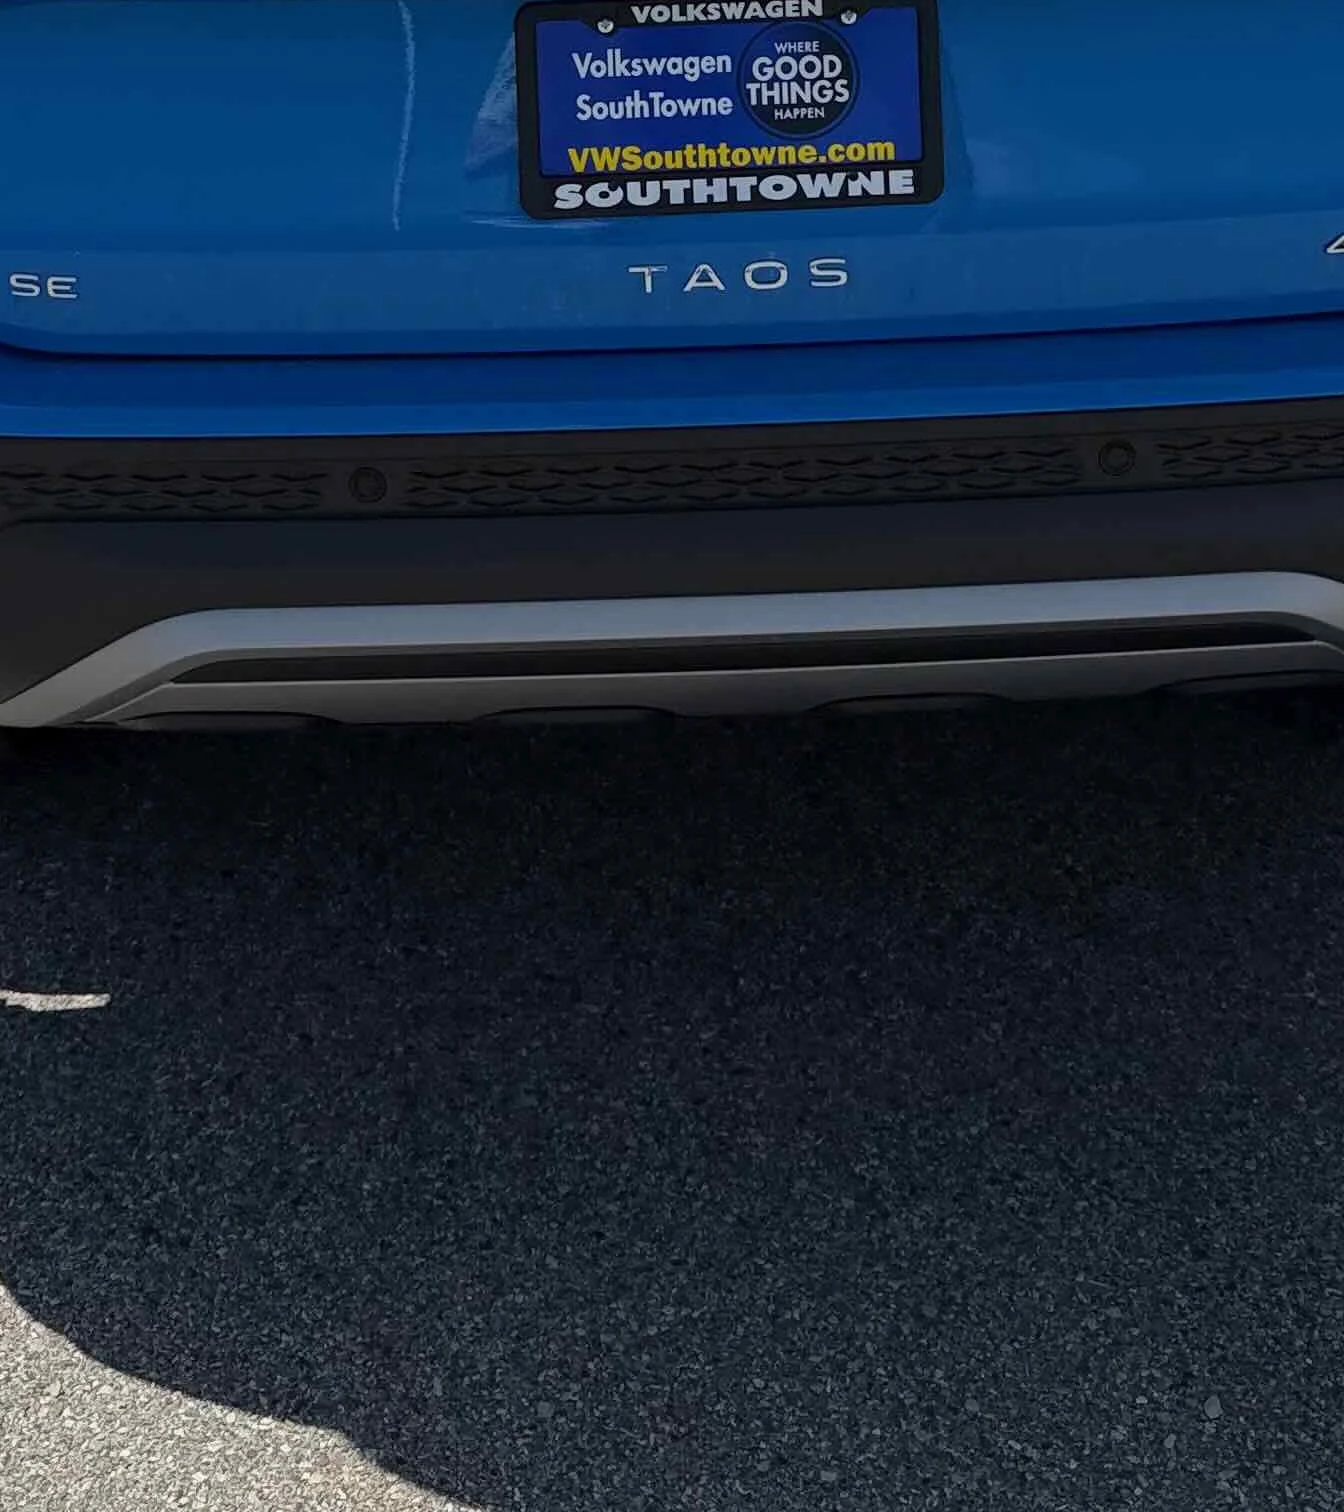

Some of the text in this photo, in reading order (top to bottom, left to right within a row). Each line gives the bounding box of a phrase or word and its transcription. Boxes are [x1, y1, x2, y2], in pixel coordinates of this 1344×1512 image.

[630, 0, 824, 24] VOLKSWAGEN
[774, 40, 821, 54] WHERE
[571, 48, 733, 82] Volkswagen
[751, 54, 843, 82] GOOD
[575, 89, 734, 122] SouthTowne
[745, 79, 850, 106] THINGS
[773, 106, 825, 121] HAPPEN
[567, 141, 896, 174] VWSouthtowne.com
[553, 169, 915, 210] SOUTHTOWNE
[9, 273, 78, 299] SE
[627, 258, 849, 295] TAOS
